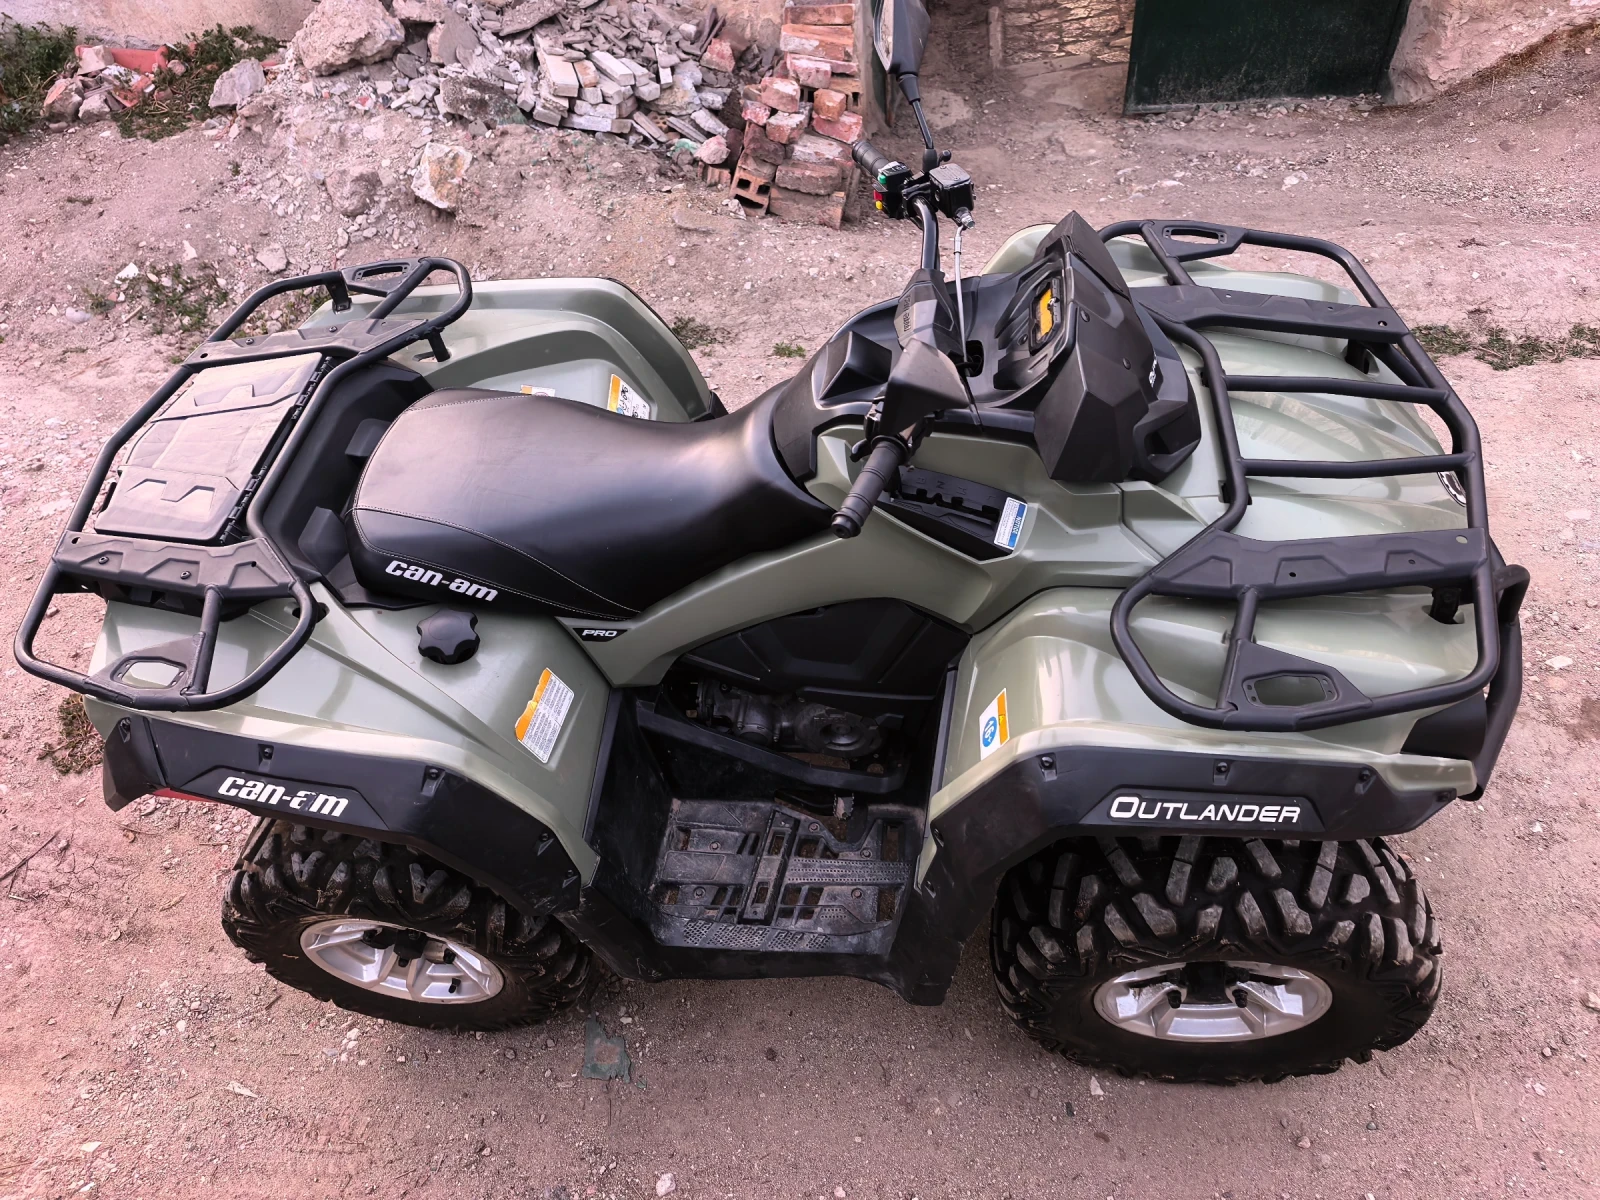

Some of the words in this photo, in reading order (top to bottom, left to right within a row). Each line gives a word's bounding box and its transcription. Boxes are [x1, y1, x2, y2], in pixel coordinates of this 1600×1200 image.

[385, 560, 499, 601] can-am
[582, 629, 618, 637] PRO
[217, 776, 349, 818] can-am
[1109, 796, 1301, 823] OUTLANDER
